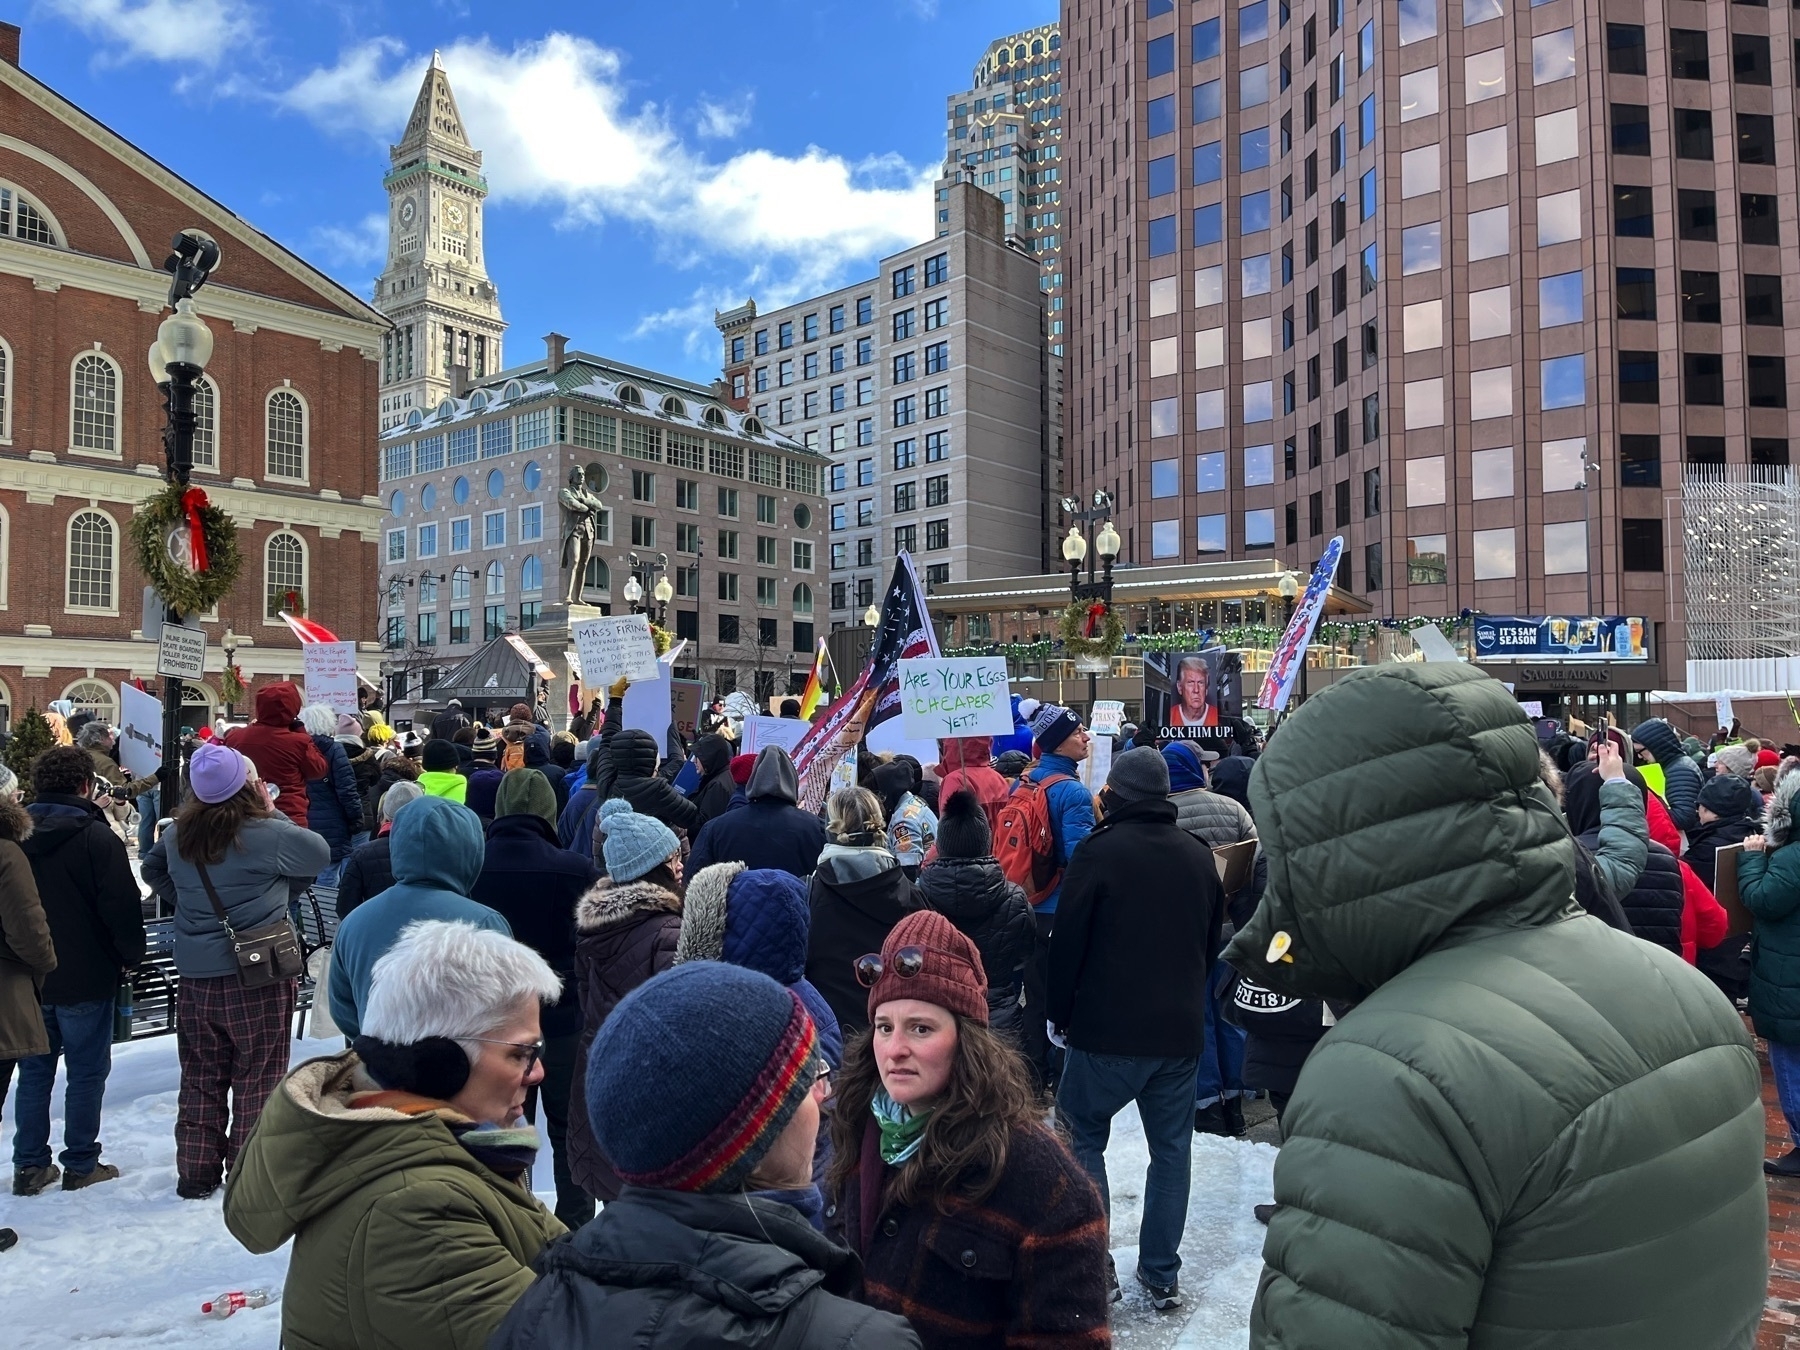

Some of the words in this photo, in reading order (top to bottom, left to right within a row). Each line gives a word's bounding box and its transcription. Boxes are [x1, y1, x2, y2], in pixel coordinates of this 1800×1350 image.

[579, 628, 612, 640] MASS
[1500, 628, 1517, 636] IT'S
[1518, 627, 1537, 636] SAM
[166, 635, 181, 643] INLINE
[182, 638, 202, 647] SKATING
[589, 637, 628, 647] DEFUNDING
[1500, 636, 1537, 645] SEASON
[163, 642, 178, 650] SKATE
[179, 645, 202, 655] BOARDING
[596, 645, 626, 654] CANCER
[162, 650, 180, 659] ROLLER
[182, 654, 201, 663] SKATING
[586, 657, 605, 665] HOW
[611, 653, 632, 662] DOES
[164, 659, 198, 671] PROHIBITED
[588, 666, 609, 676] HELP
[904, 669, 930, 691] ARE
[936, 667, 975, 691] YOUR
[977, 667, 1007, 687] EGGS
[1522, 668, 1567, 682] SAMUEL
[1569, 668, 1610, 682] ADAMS
[1188, 727, 1212, 738] HIM
[1215, 726, 1234, 738] UP!
